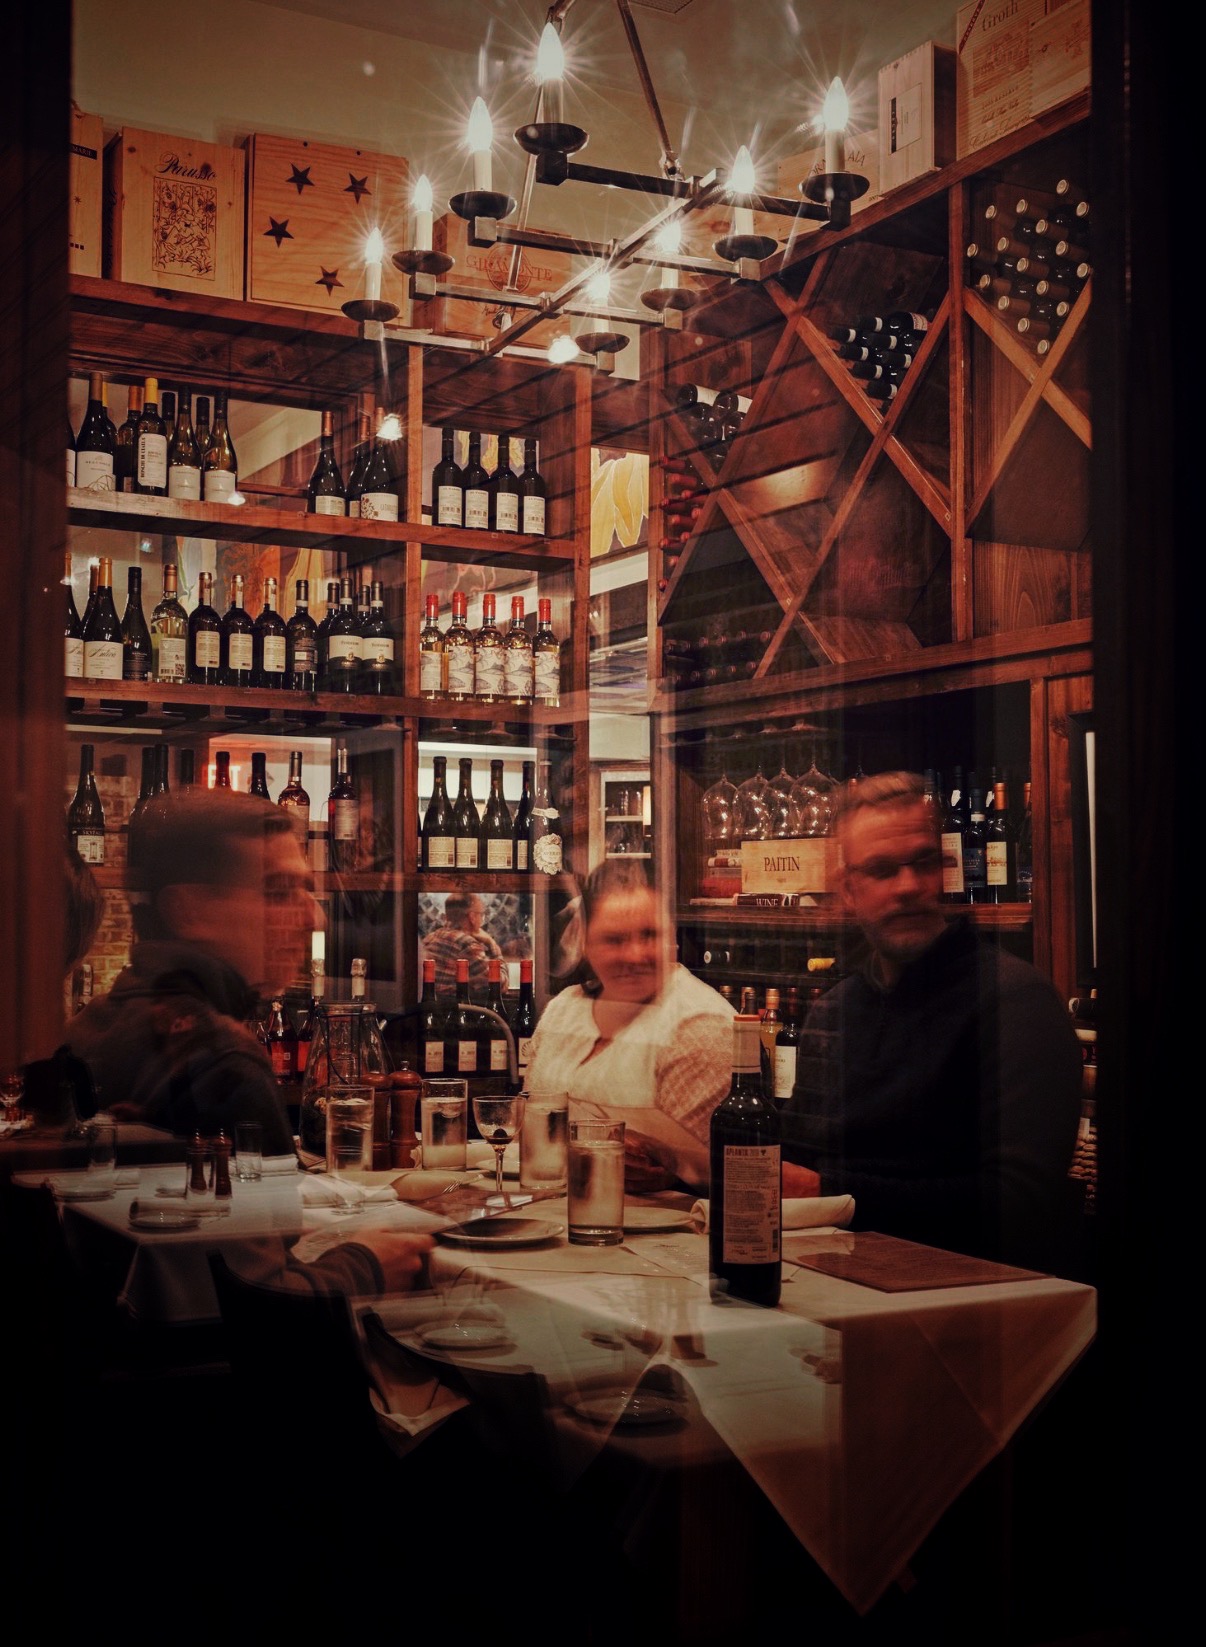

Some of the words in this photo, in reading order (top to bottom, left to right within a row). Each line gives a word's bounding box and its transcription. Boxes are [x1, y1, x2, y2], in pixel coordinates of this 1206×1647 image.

[982, 0, 1019, 32] Groth
[154, 150, 216, 181] Parusso
[763, 856, 800, 872] PAITIN
